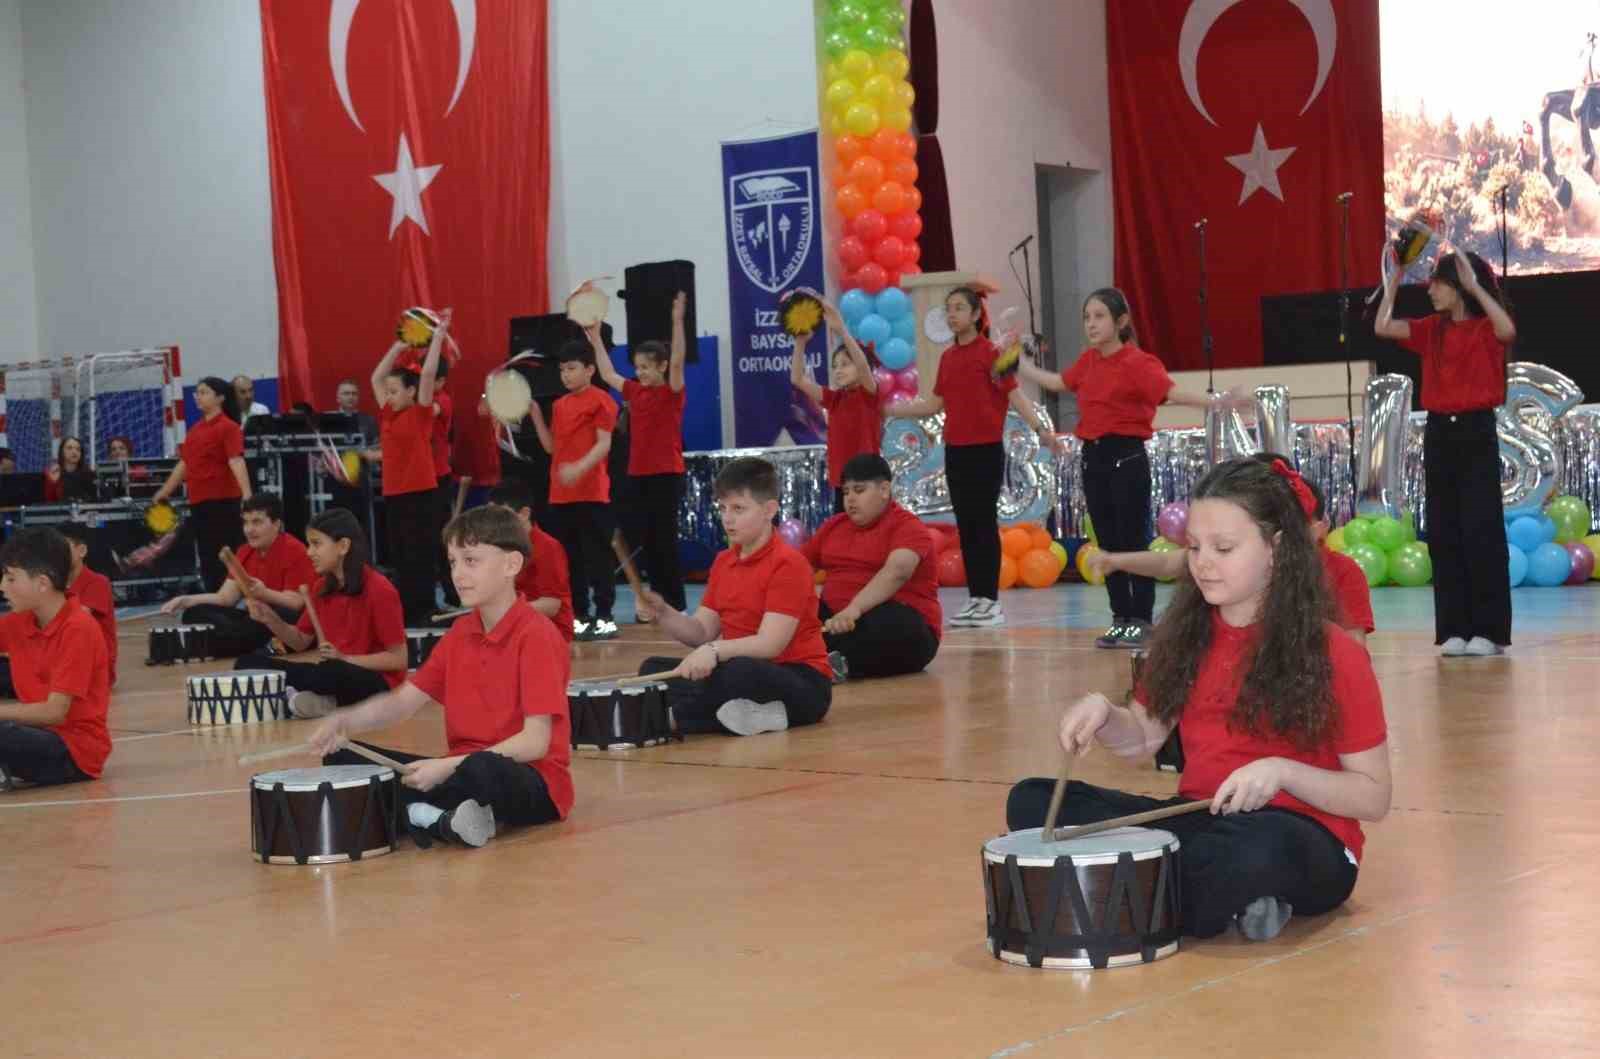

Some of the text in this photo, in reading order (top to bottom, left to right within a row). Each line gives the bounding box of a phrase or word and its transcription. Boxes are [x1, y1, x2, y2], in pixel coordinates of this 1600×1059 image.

[755, 308, 780, 327] İZZ
[751, 333, 796, 350] BAYSA
[738, 352, 822, 373] ORTAOKLU
